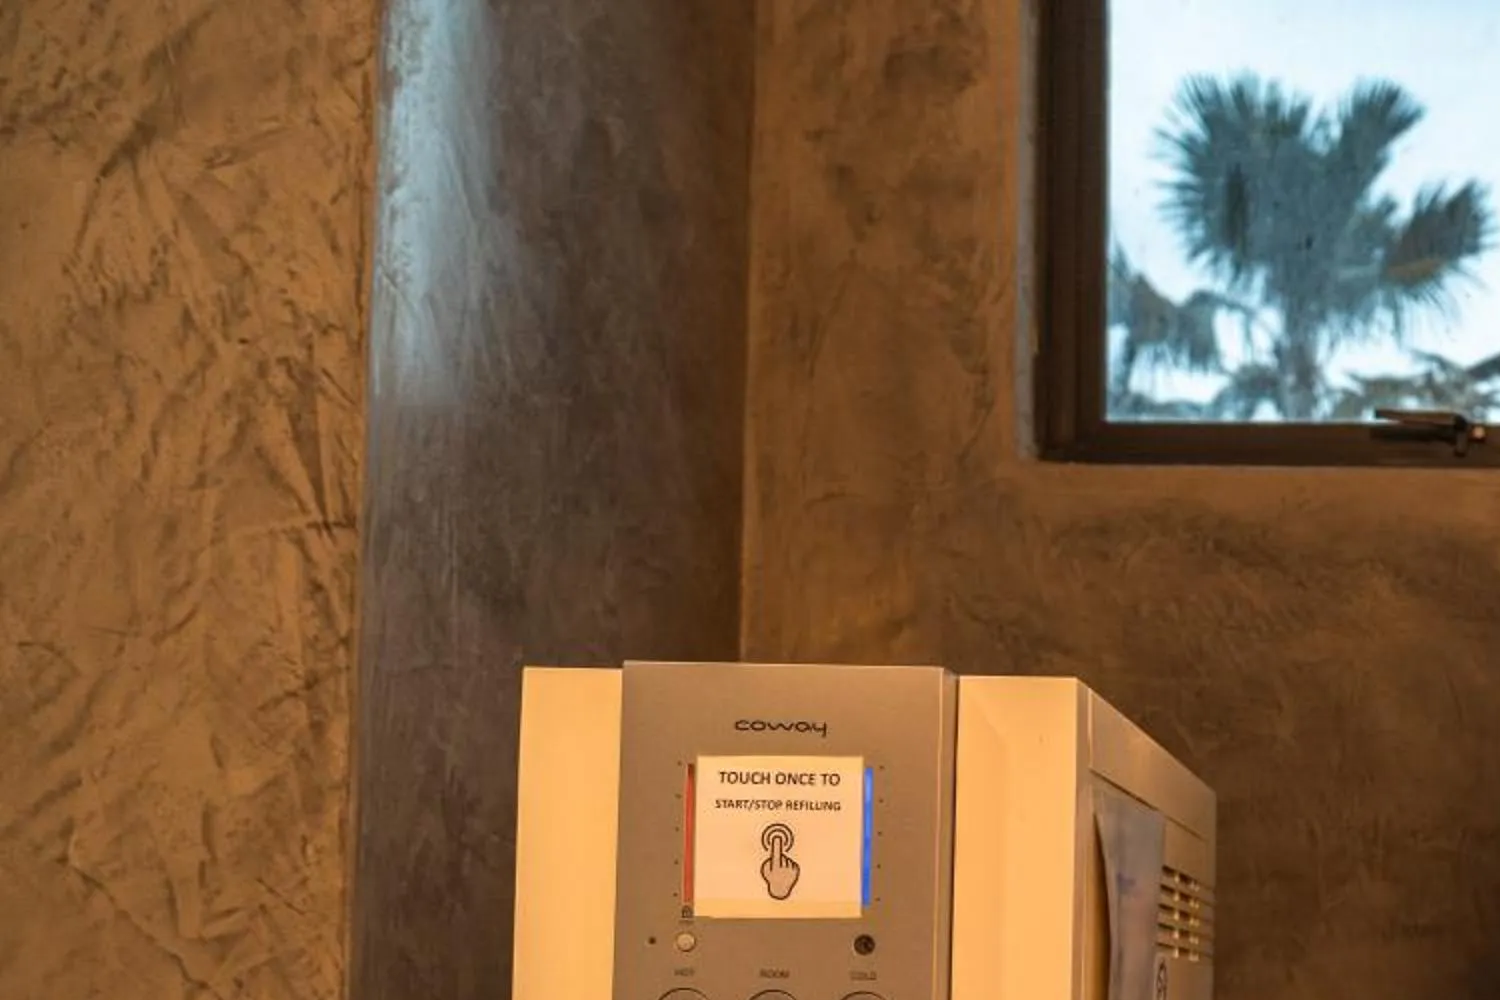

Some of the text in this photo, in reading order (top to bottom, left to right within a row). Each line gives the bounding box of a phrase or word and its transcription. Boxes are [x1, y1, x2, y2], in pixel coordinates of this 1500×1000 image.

[735, 719, 827, 738] coway
[719, 771, 841, 786] TOUCH ONCE TO
[715, 799, 841, 811] START/STOP REFILLING
[759, 968, 790, 979] ROOM
